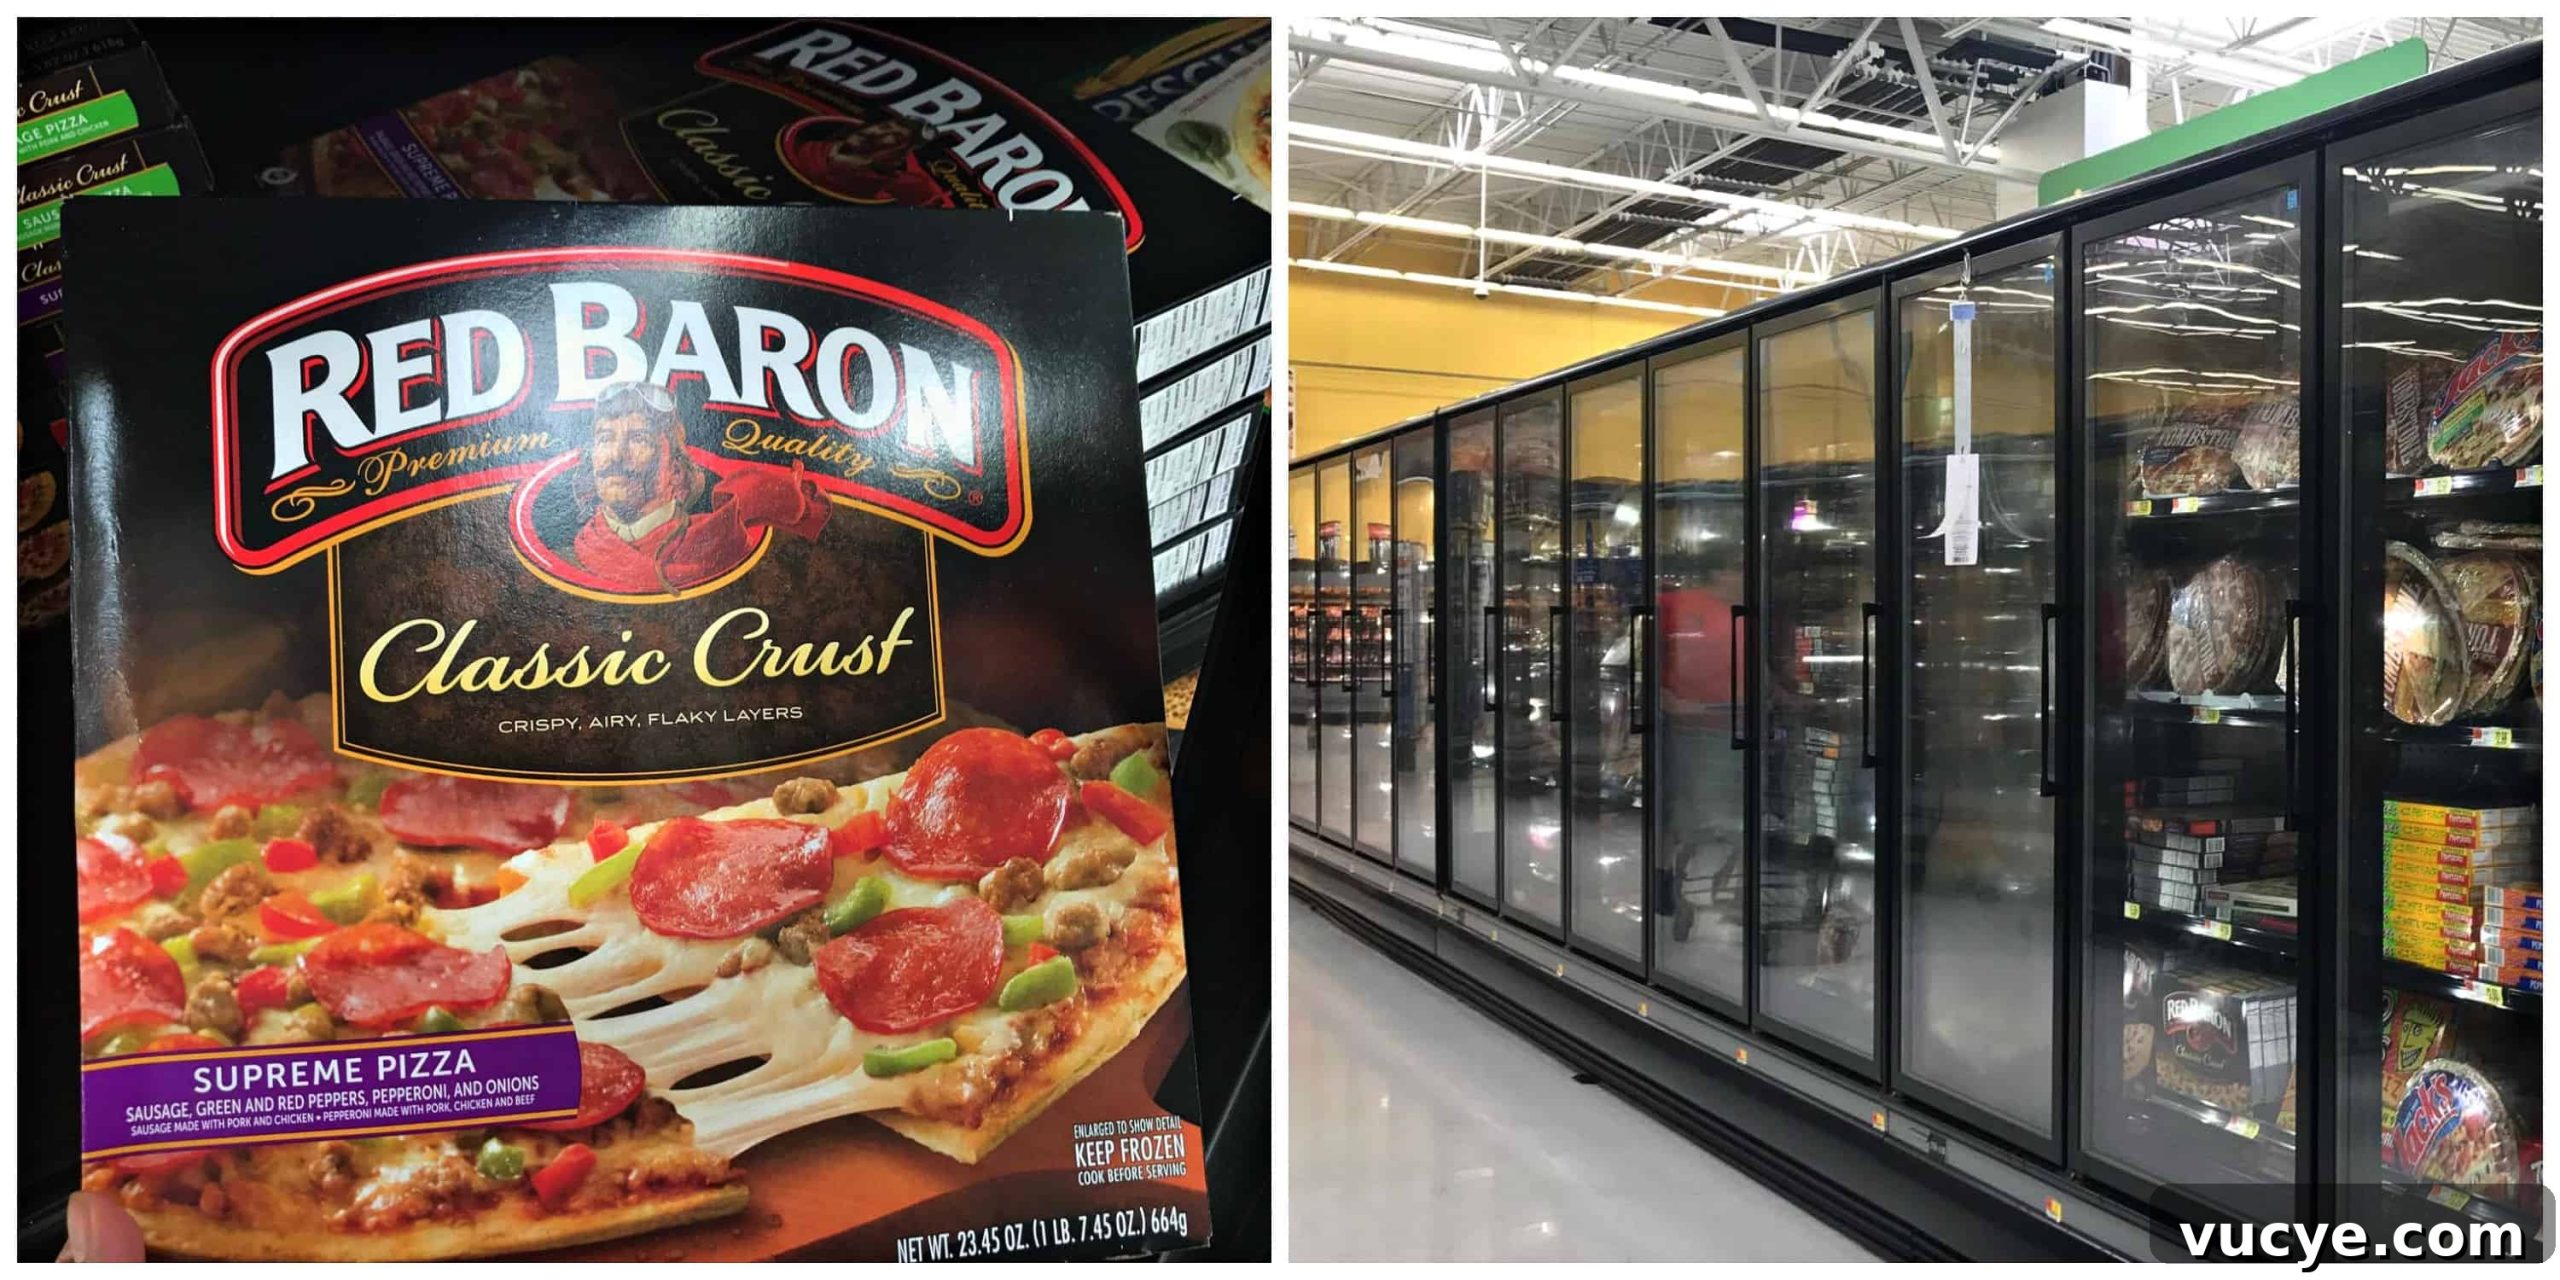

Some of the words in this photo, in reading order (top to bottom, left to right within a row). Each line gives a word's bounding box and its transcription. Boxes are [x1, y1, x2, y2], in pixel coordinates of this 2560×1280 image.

[29, 79, 84, 113] Crust
[45, 113, 88, 135] PIZZA
[753, 28, 918, 94] RED
[890, 78, 1091, 211] BARO
[657, 109, 775, 199] Classic
[17, 178, 73, 205] lassic
[76, 153, 128, 186] Crust
[264, 309, 530, 482] RED
[548, 281, 981, 468] BARON
[357, 431, 550, 496] Premium
[721, 418, 877, 478] Quality
[359, 618, 671, 703] Classic
[693, 606, 914, 687] Crust
[498, 717, 582, 734] CRISPY,
[589, 714, 641, 729] AIRY,
[648, 710, 718, 726] FLAKY
[723, 706, 803, 722] LAYERS
[194, 1057, 363, 1093] SUPREME
[378, 1048, 476, 1081] PIZZA
[126, 1102, 192, 1123] SAUSAGE,
[196, 1099, 241, 1117] GREEN
[245, 1096, 274, 1114] AND
[278, 1094, 304, 1111] RED
[308, 1090, 369, 1109] PEPPERS,
[372, 1084, 450, 1104] PEPPERONI,
[454, 1080, 482, 1097] AND
[485, 1075, 540, 1095] ONIONS
[131, 1123, 172, 1137] SAUSAGE
[174, 1119, 199, 1132] MADE
[202, 1117, 225, 1131] WITH
[227, 1115, 251, 1129] PORK
[253, 1113, 272, 1126] AND
[274, 1111, 314, 1125] CHICKEN
[323, 1108, 372, 1122] PEPPERONI
[374, 1105, 399, 1118] MADE
[400, 1103, 424, 1116] WITH
[454, 1098, 493, 1111] CHICKEN
[494, 1095, 514, 1108] AND
[515, 1093, 536, 1105] BEEF
[1074, 1121, 1115, 1139] ENLARGED
[1117, 1119, 1127, 1134] TO
[1129, 1117, 1154, 1133] SHOW
[1155, 1115, 1182, 1130] DETAIL
[1075, 1140, 1115, 1168] KEEP
[1120, 1133, 1186, 1163] FROZEN
[1078, 1170, 1106, 1186] COOK
[1107, 1165, 1144, 1183] BEFORE
[1146, 1162, 1187, 1179] SERVING
[896, 1236, 924, 1263] NET
[928, 1233, 953, 1261] WT.
[958, 1227, 1000, 1258] 23.45
[1004, 1223, 1029, 1252] OZ.
[1032, 1219, 1047, 1249] (1
[1052, 1216, 1076, 1246] LB.
[1079, 1212, 1111, 1242] 7.45
[1116, 1207, 1146, 1238] OZ.)
[1151, 1206, 1188, 1237] 664g
